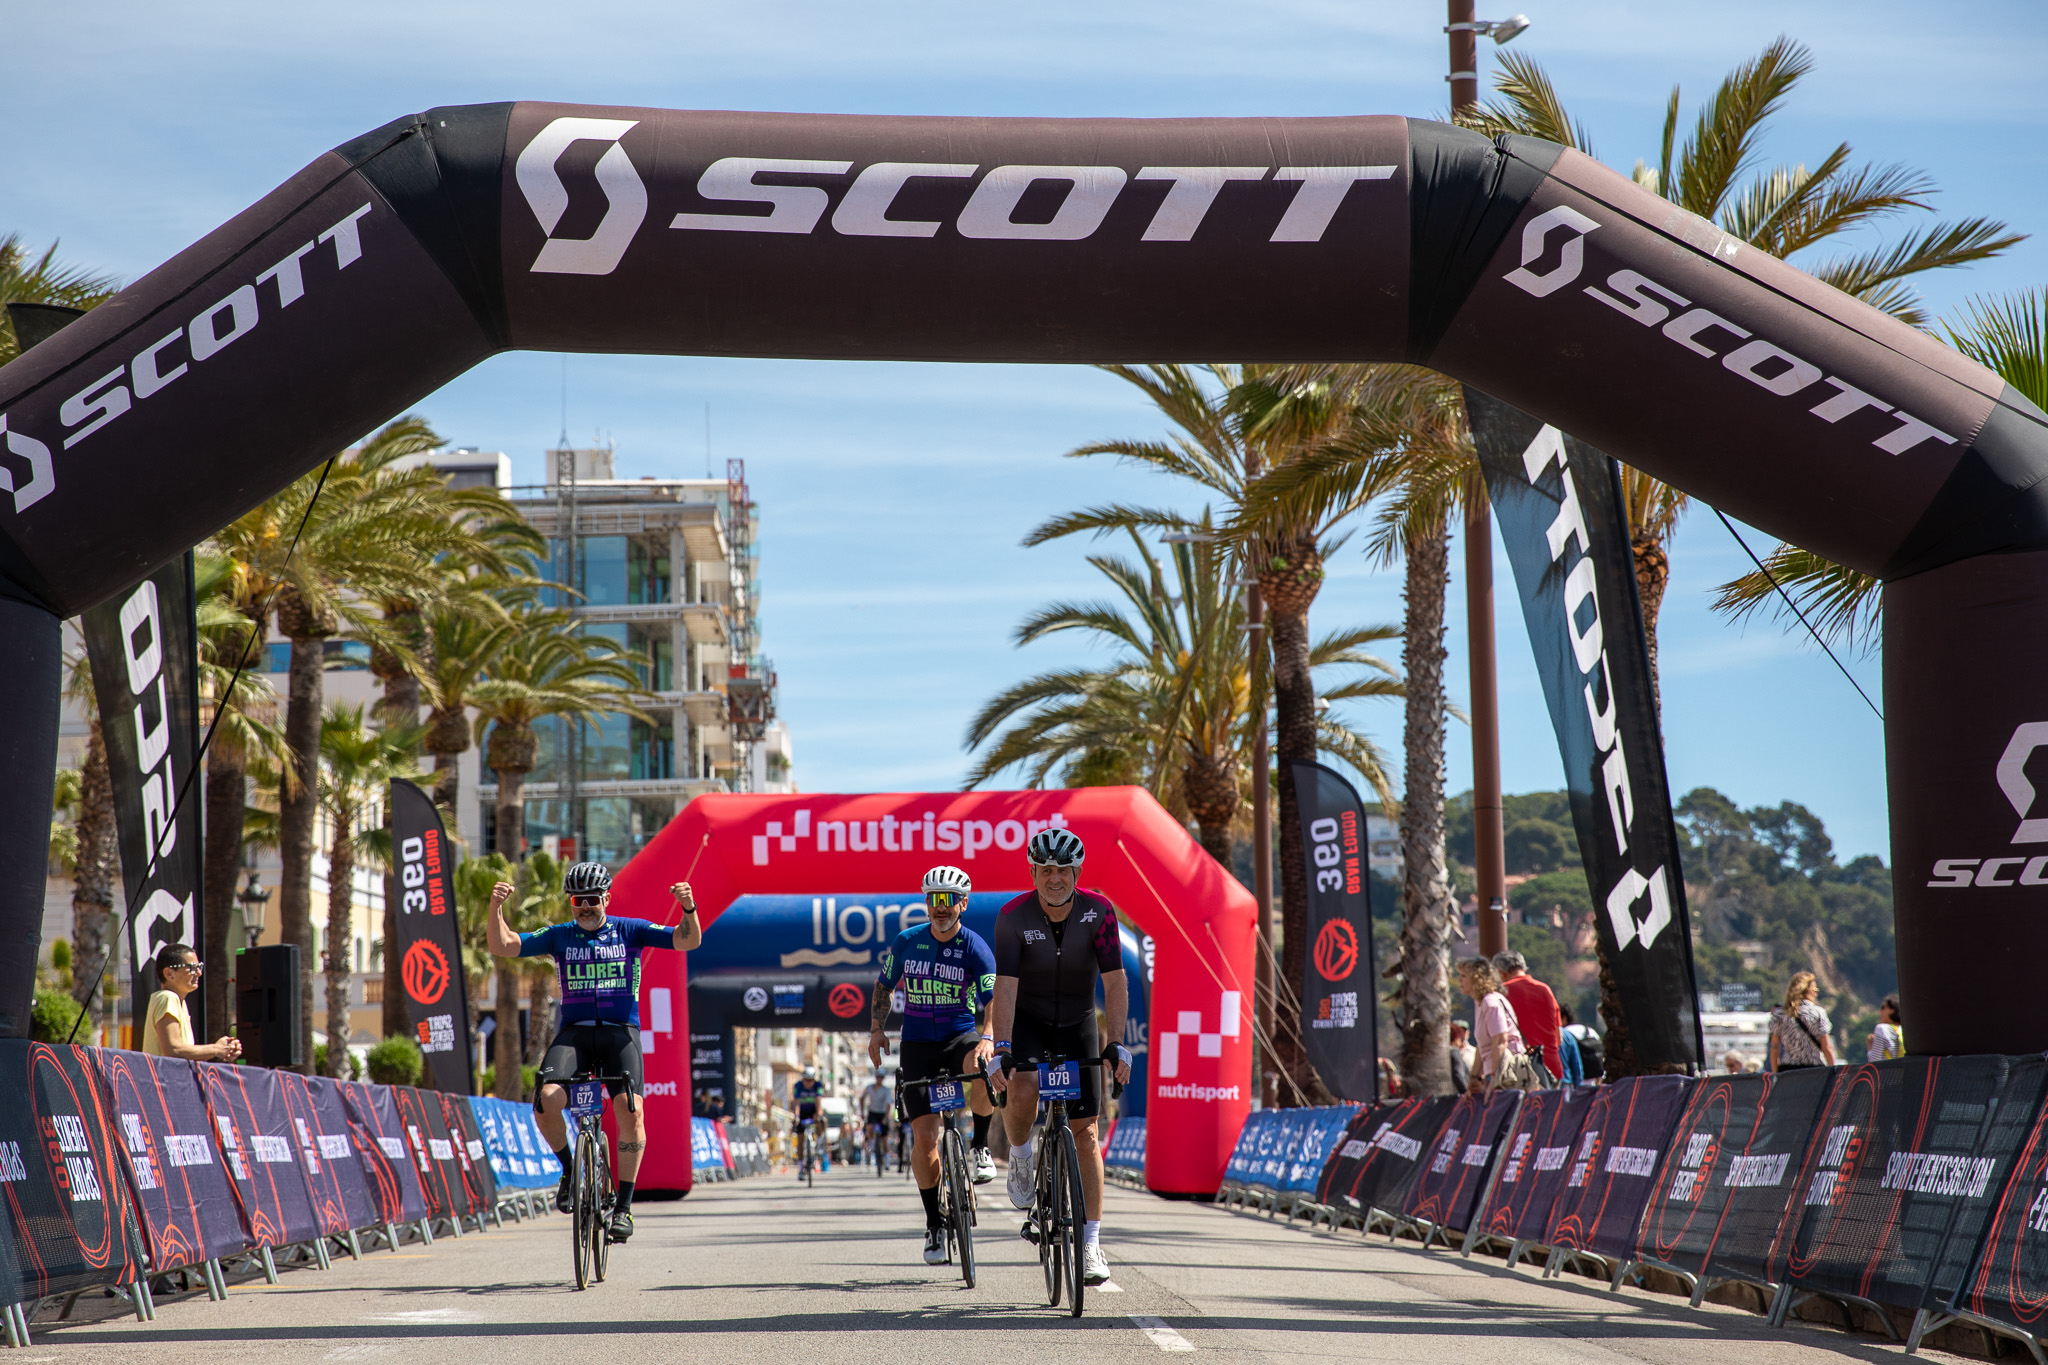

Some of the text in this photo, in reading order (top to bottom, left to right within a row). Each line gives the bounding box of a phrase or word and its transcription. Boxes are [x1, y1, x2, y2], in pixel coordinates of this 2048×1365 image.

[668, 157, 1398, 242] SCOTT
[60, 202, 371, 450] SCOTT
[1583, 269, 1958, 456] SCOTT
[1927, 856, 2048, 888] SCO
[812, 898, 928, 946] llore
[565, 943, 626, 961] GRAN FONDO
[566, 961, 627, 980] LLORET
[904, 959, 930, 976] GRAN
[933, 962, 965, 982] FONDO
[568, 977, 627, 991] COSTA BRAVA
[905, 977, 962, 998] LLORET
[908, 993, 933, 1005] COSTA
[1048, 1071, 1070, 1086] 878
[576, 1091, 594, 1104] 672
[936, 1085, 956, 1099] 538
[1158, 1083, 1240, 1102] nutrisport
[1818, 1125, 1855, 1167] SPORT
[65, 1156, 102, 1202] SPORT
[1881, 1151, 1997, 1198] SPORTEVENTS360.COM
